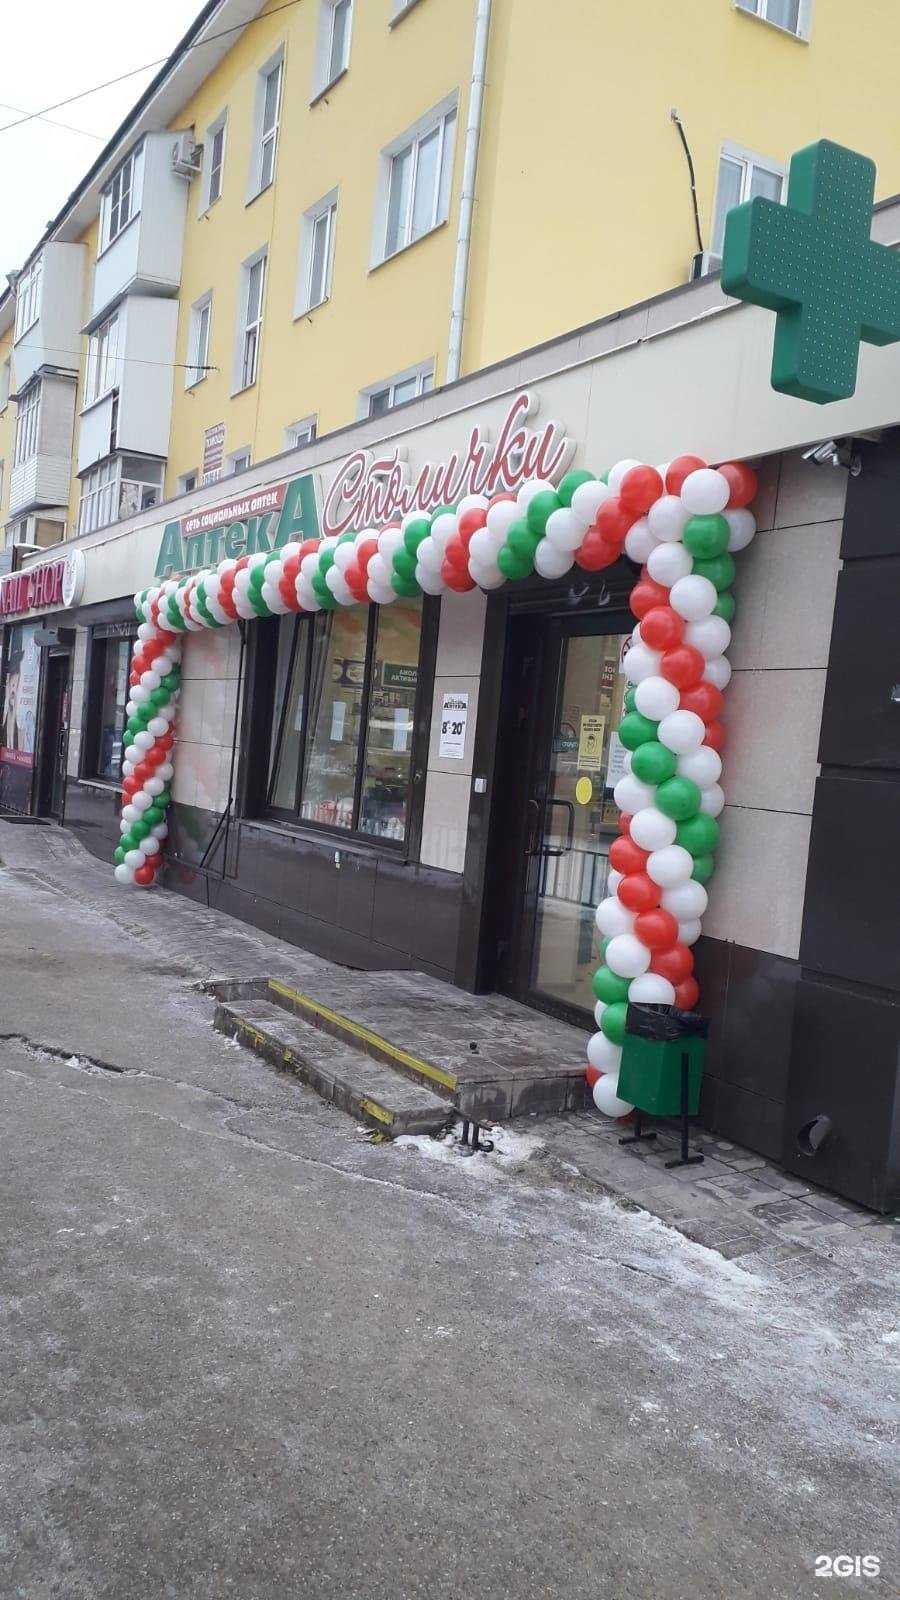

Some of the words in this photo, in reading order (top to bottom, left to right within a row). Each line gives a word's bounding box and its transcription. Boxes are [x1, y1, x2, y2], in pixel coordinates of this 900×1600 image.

[186, 517, 200, 532] сеть
[201, 501, 251, 527] социальных
[251, 491, 278, 508] аптек
[322, 391, 568, 538] Столички
